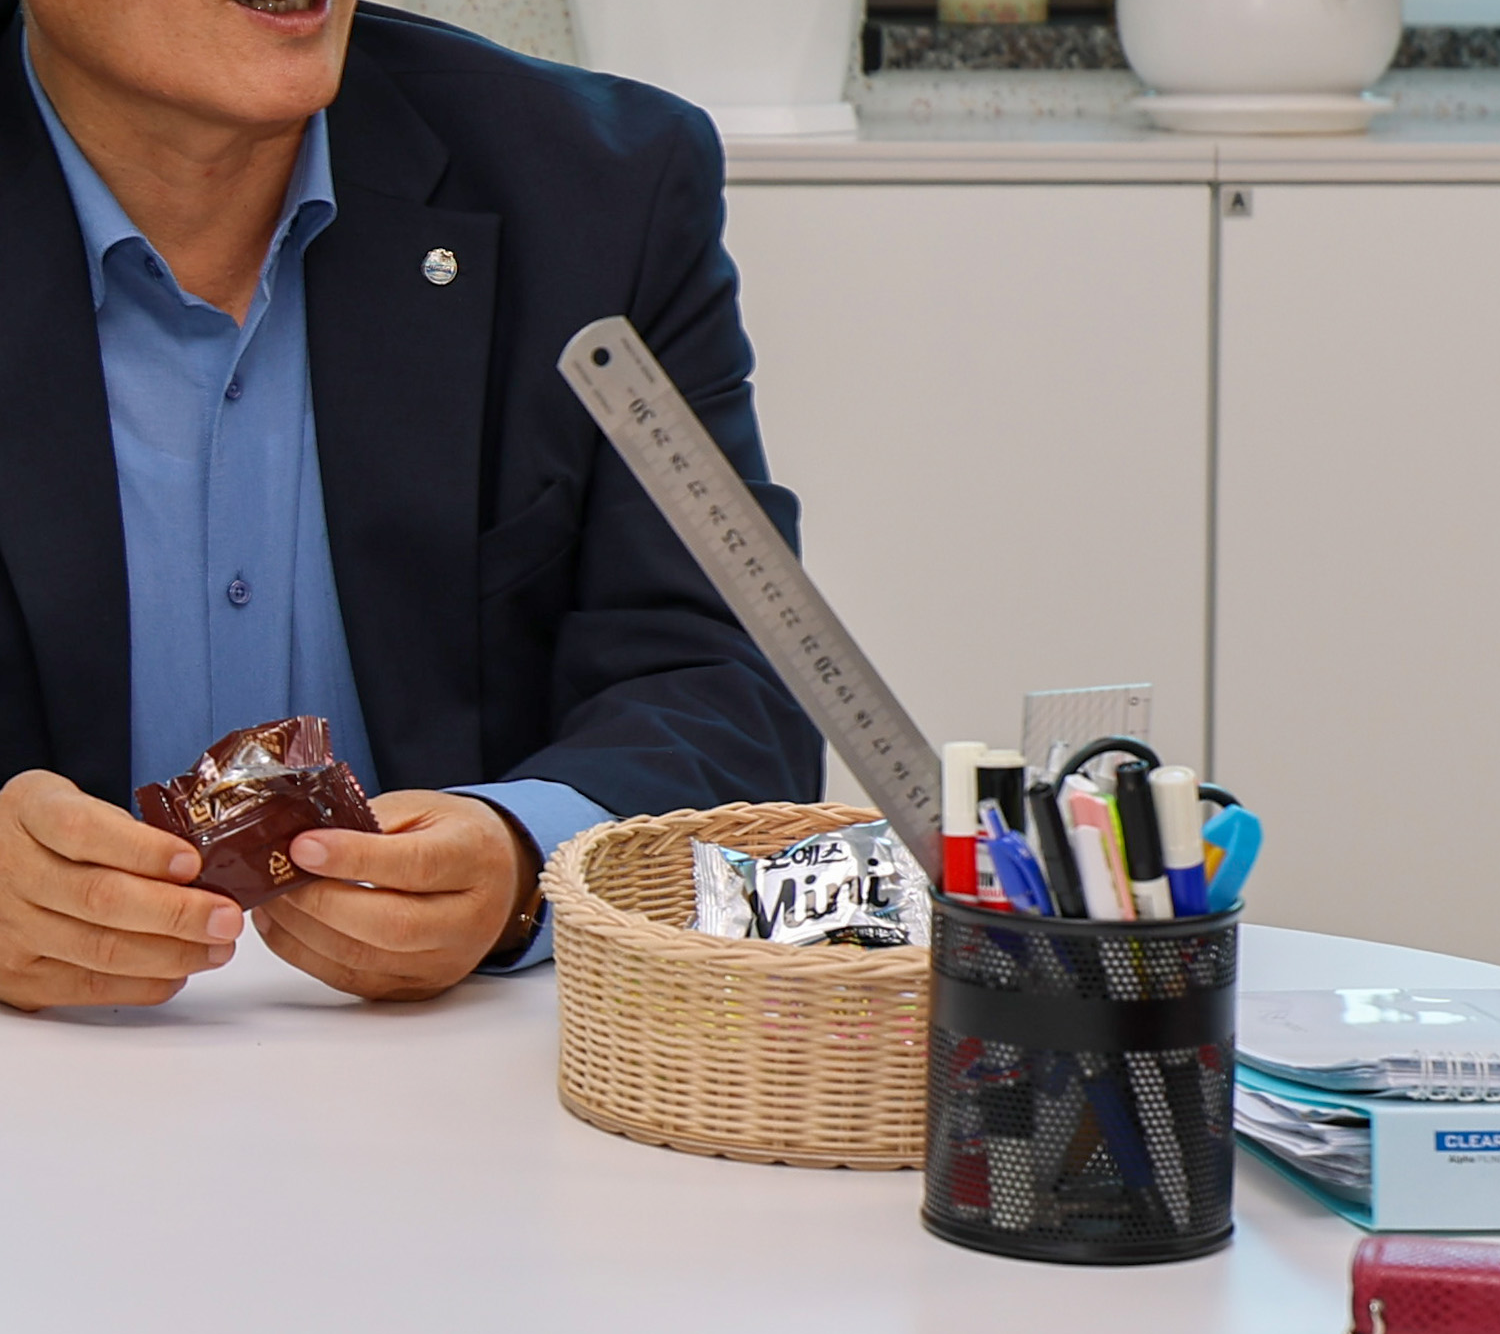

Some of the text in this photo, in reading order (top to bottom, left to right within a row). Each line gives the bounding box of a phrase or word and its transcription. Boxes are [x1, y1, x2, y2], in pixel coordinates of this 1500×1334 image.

[628, 397, 658, 425] 30
[721, 528, 747, 554] 25
[814, 655, 842, 685] 20
[907, 785, 931, 810] 15
